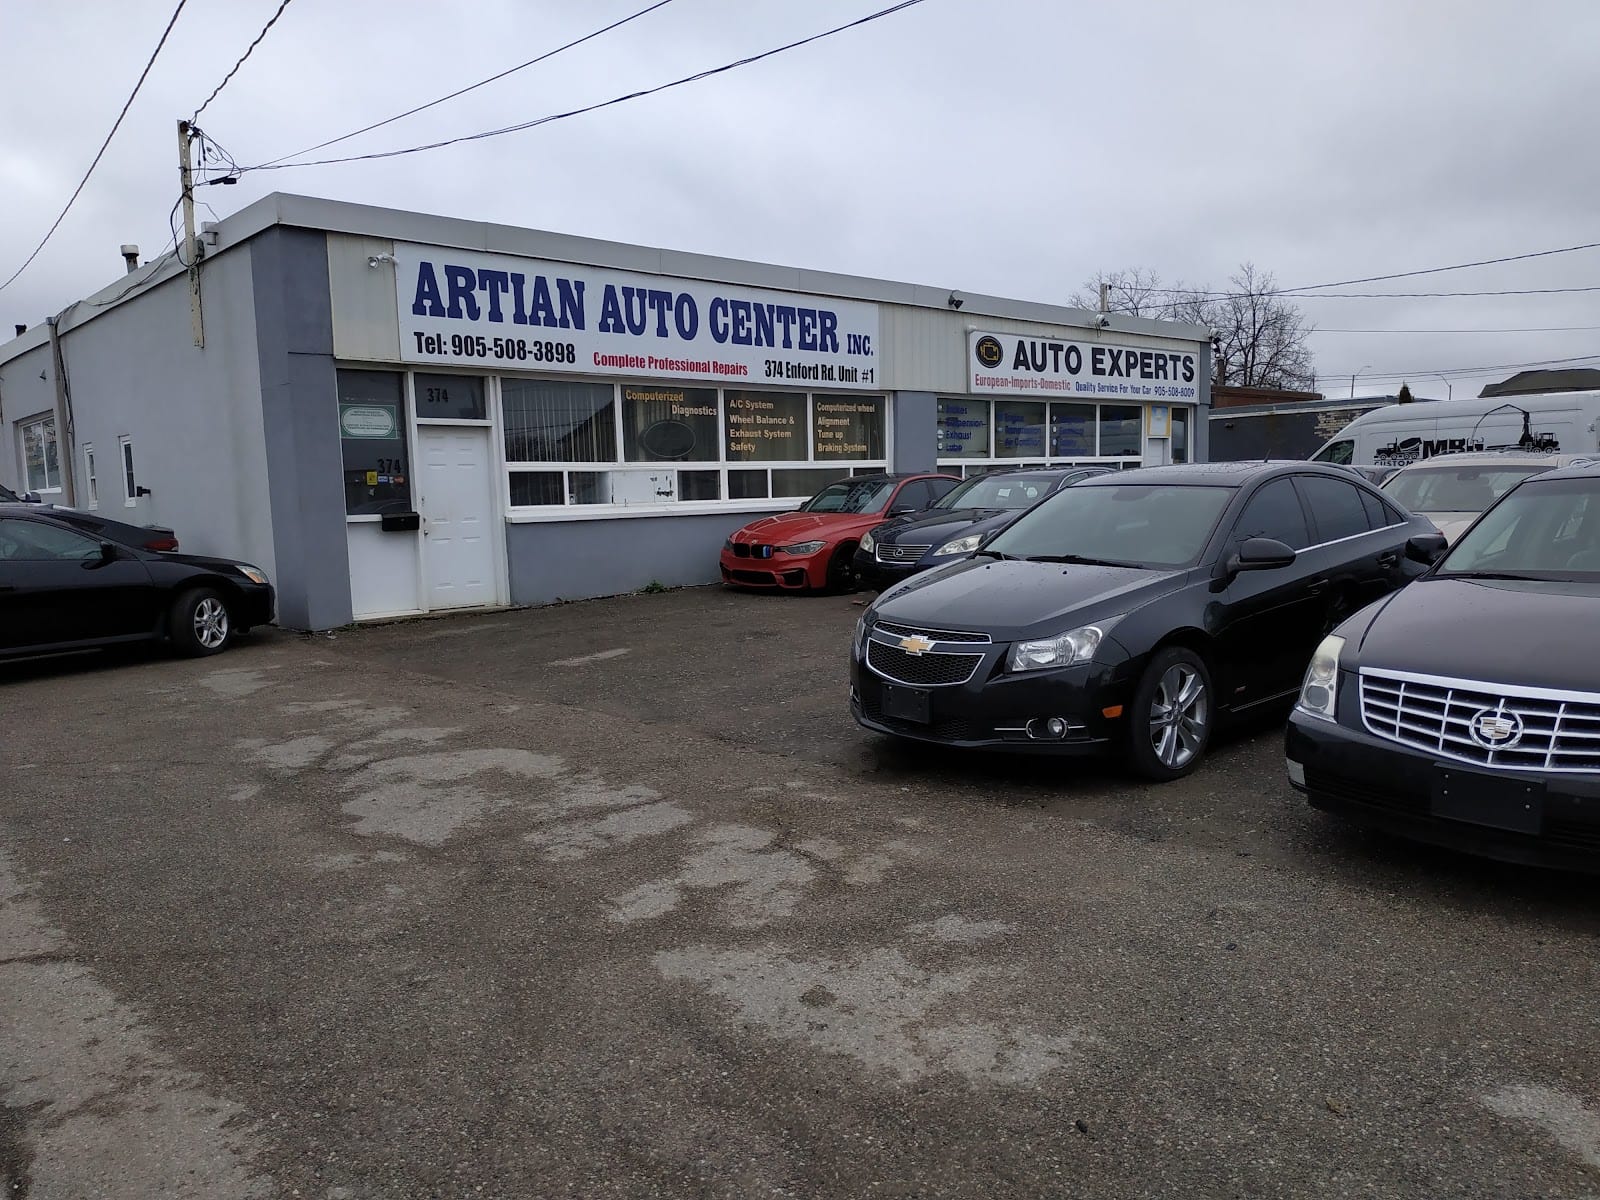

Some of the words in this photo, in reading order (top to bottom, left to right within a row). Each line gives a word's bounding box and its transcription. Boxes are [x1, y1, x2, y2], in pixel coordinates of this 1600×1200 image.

[412, 261, 585, 330] ARTIAN
[599, 284, 699, 341] AUTO
[709, 297, 839, 353] CENTER
[847, 333, 873, 356] INC.
[413, 331, 447, 355] Tel:
[451, 334, 576, 364] 905-508-3898
[593, 351, 646, 369] Complete
[648, 355, 711, 373] Professional
[712, 360, 748, 376] Repairs
[1012, 339, 1082, 375] AUTO
[1091, 347, 1195, 383] EXPERTS
[765, 360, 783, 378] 374
[785, 361, 819, 380] Enford
[821, 364, 836, 381] Rd.
[838, 365, 857, 383] Unit
[861, 367, 874, 384] #1
[1075, 381, 1096, 394] Quality
[1097, 382, 1118, 393] Service
[1119, 383, 1129, 394] For
[1130, 384, 1141, 395] Your
[1142, 385, 1152, 395] Car
[427, 387, 449, 403] 374
[625, 389, 684, 403] Computerized
[671, 404, 717, 417] Diagnostics
[729, 399, 744, 409] A/C
[745, 399, 774, 410] System
[817, 402, 857, 414] Computerized
[729, 414, 755, 424] Wheel
[756, 415, 787, 425] Balance
[789, 416, 795, 425] &
[817, 416, 850, 428] Alignment
[729, 428, 762, 438] Exhaust
[763, 429, 792, 440] System
[817, 429, 834, 439] Tune
[834, 431, 844, 441] up
[946, 430, 972, 440] Exhaust
[730, 441, 756, 453] Safety
[817, 442, 843, 454] Braking
[843, 442, 868, 454] System
[377, 458, 401, 474] 374
